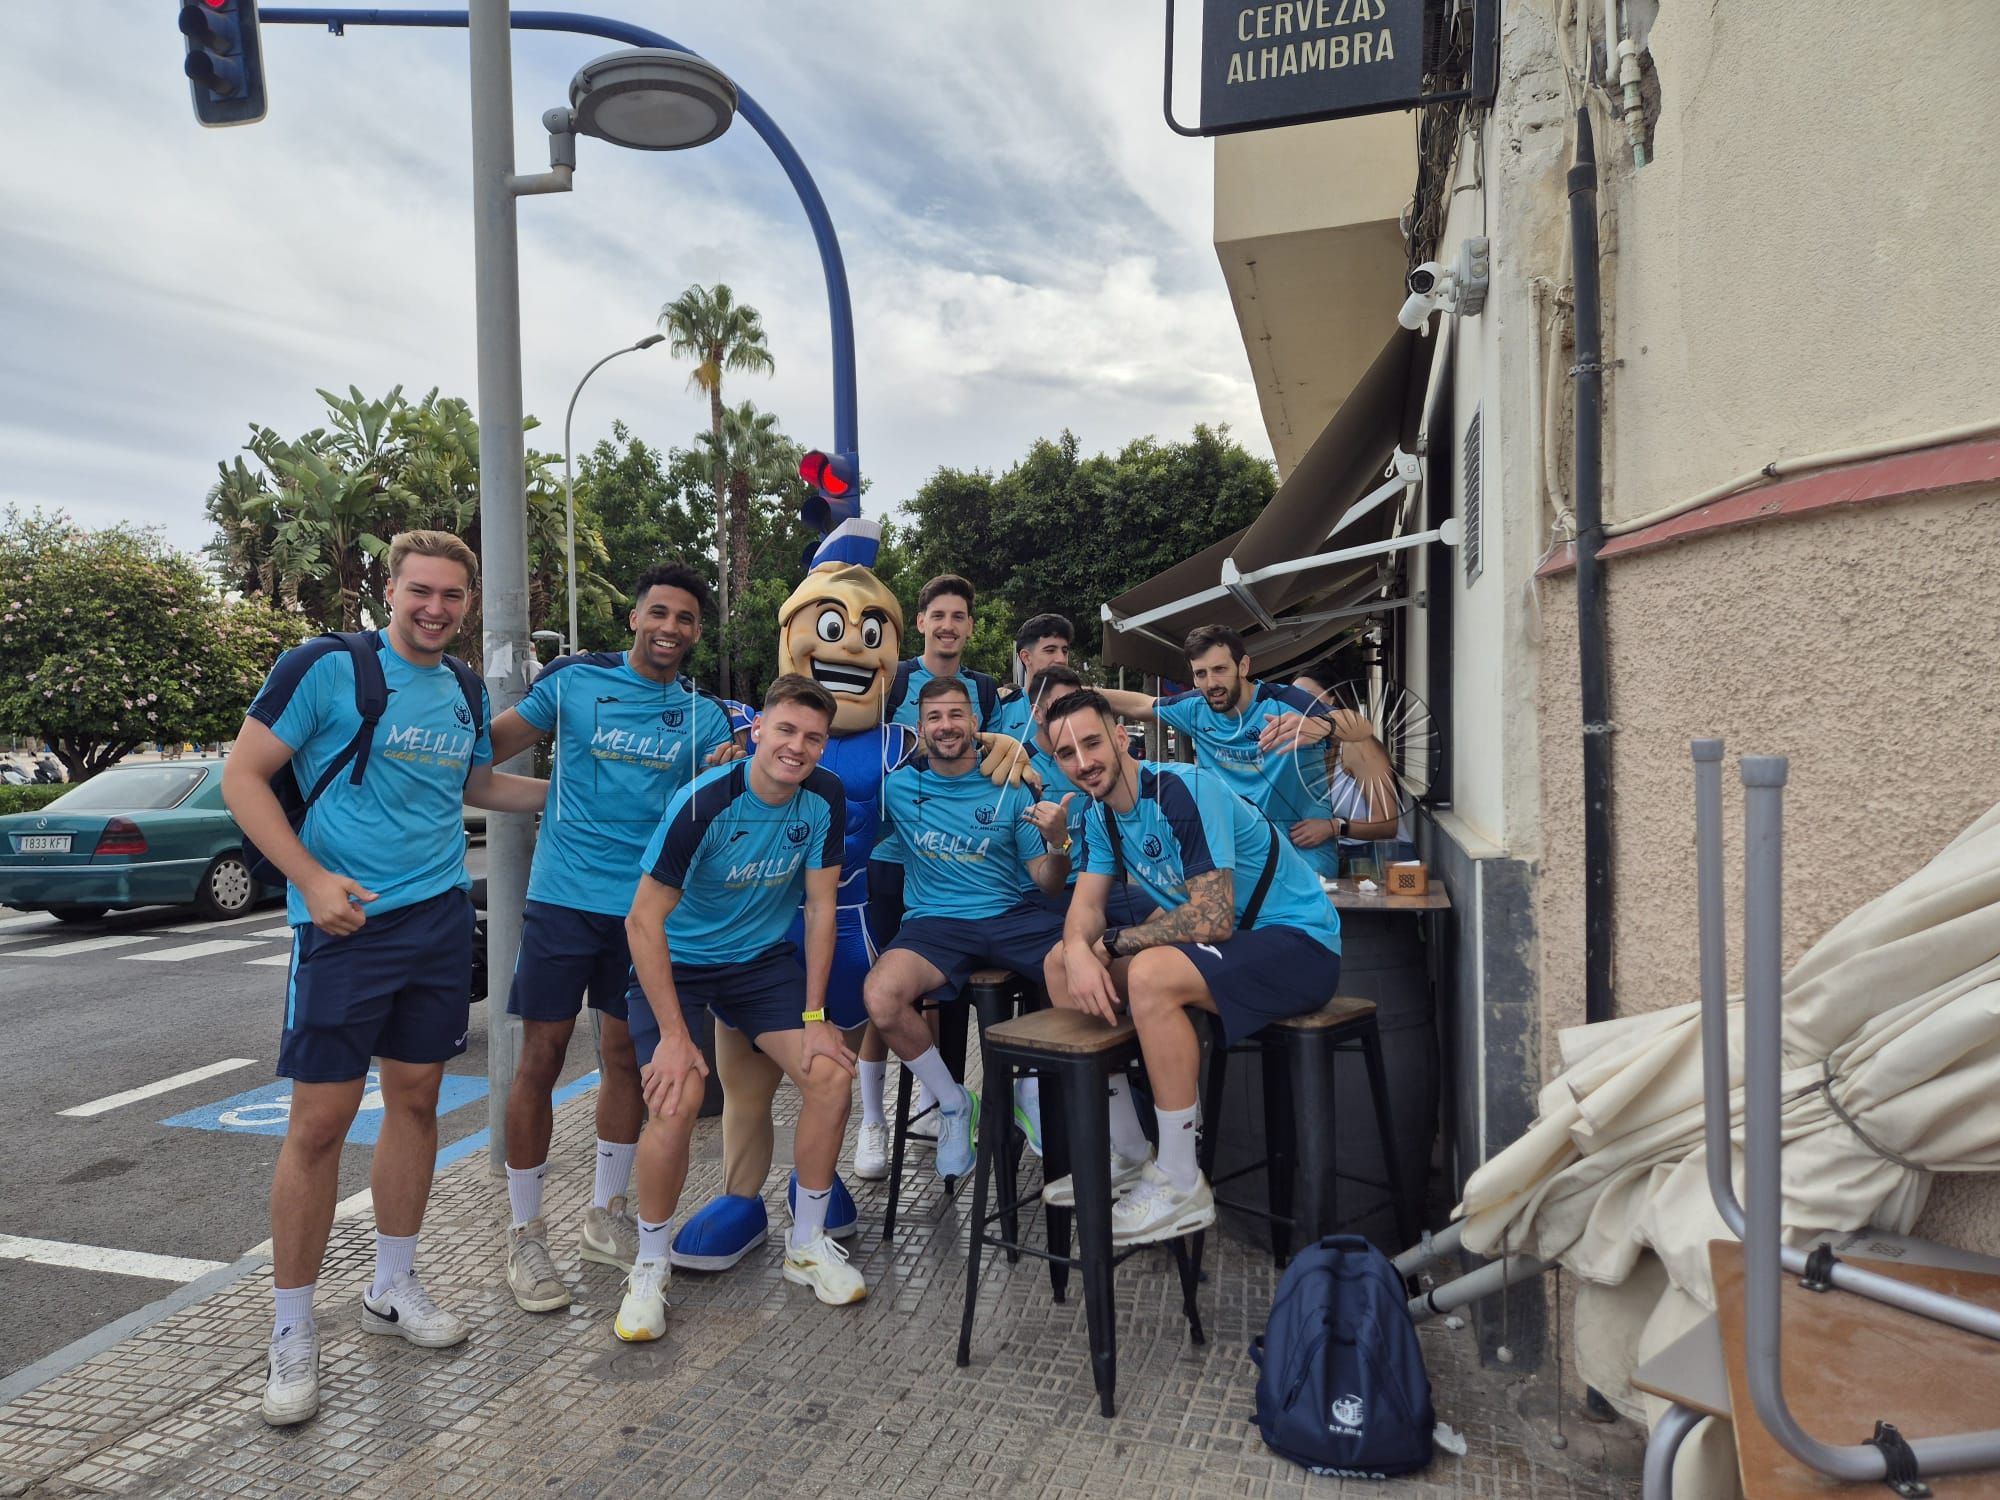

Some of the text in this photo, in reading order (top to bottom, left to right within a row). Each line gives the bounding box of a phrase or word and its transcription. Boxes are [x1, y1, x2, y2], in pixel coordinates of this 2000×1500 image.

[1238, 0, 1386, 42] CERVEZAS
[1226, 28, 1395, 85] ALHAMBRA
[386, 724, 472, 759] MELILLA
[591, 726, 681, 762] MELILLA
[25, 837, 69, 849] 1833 KFT
[913, 830, 991, 857] MELILLA
